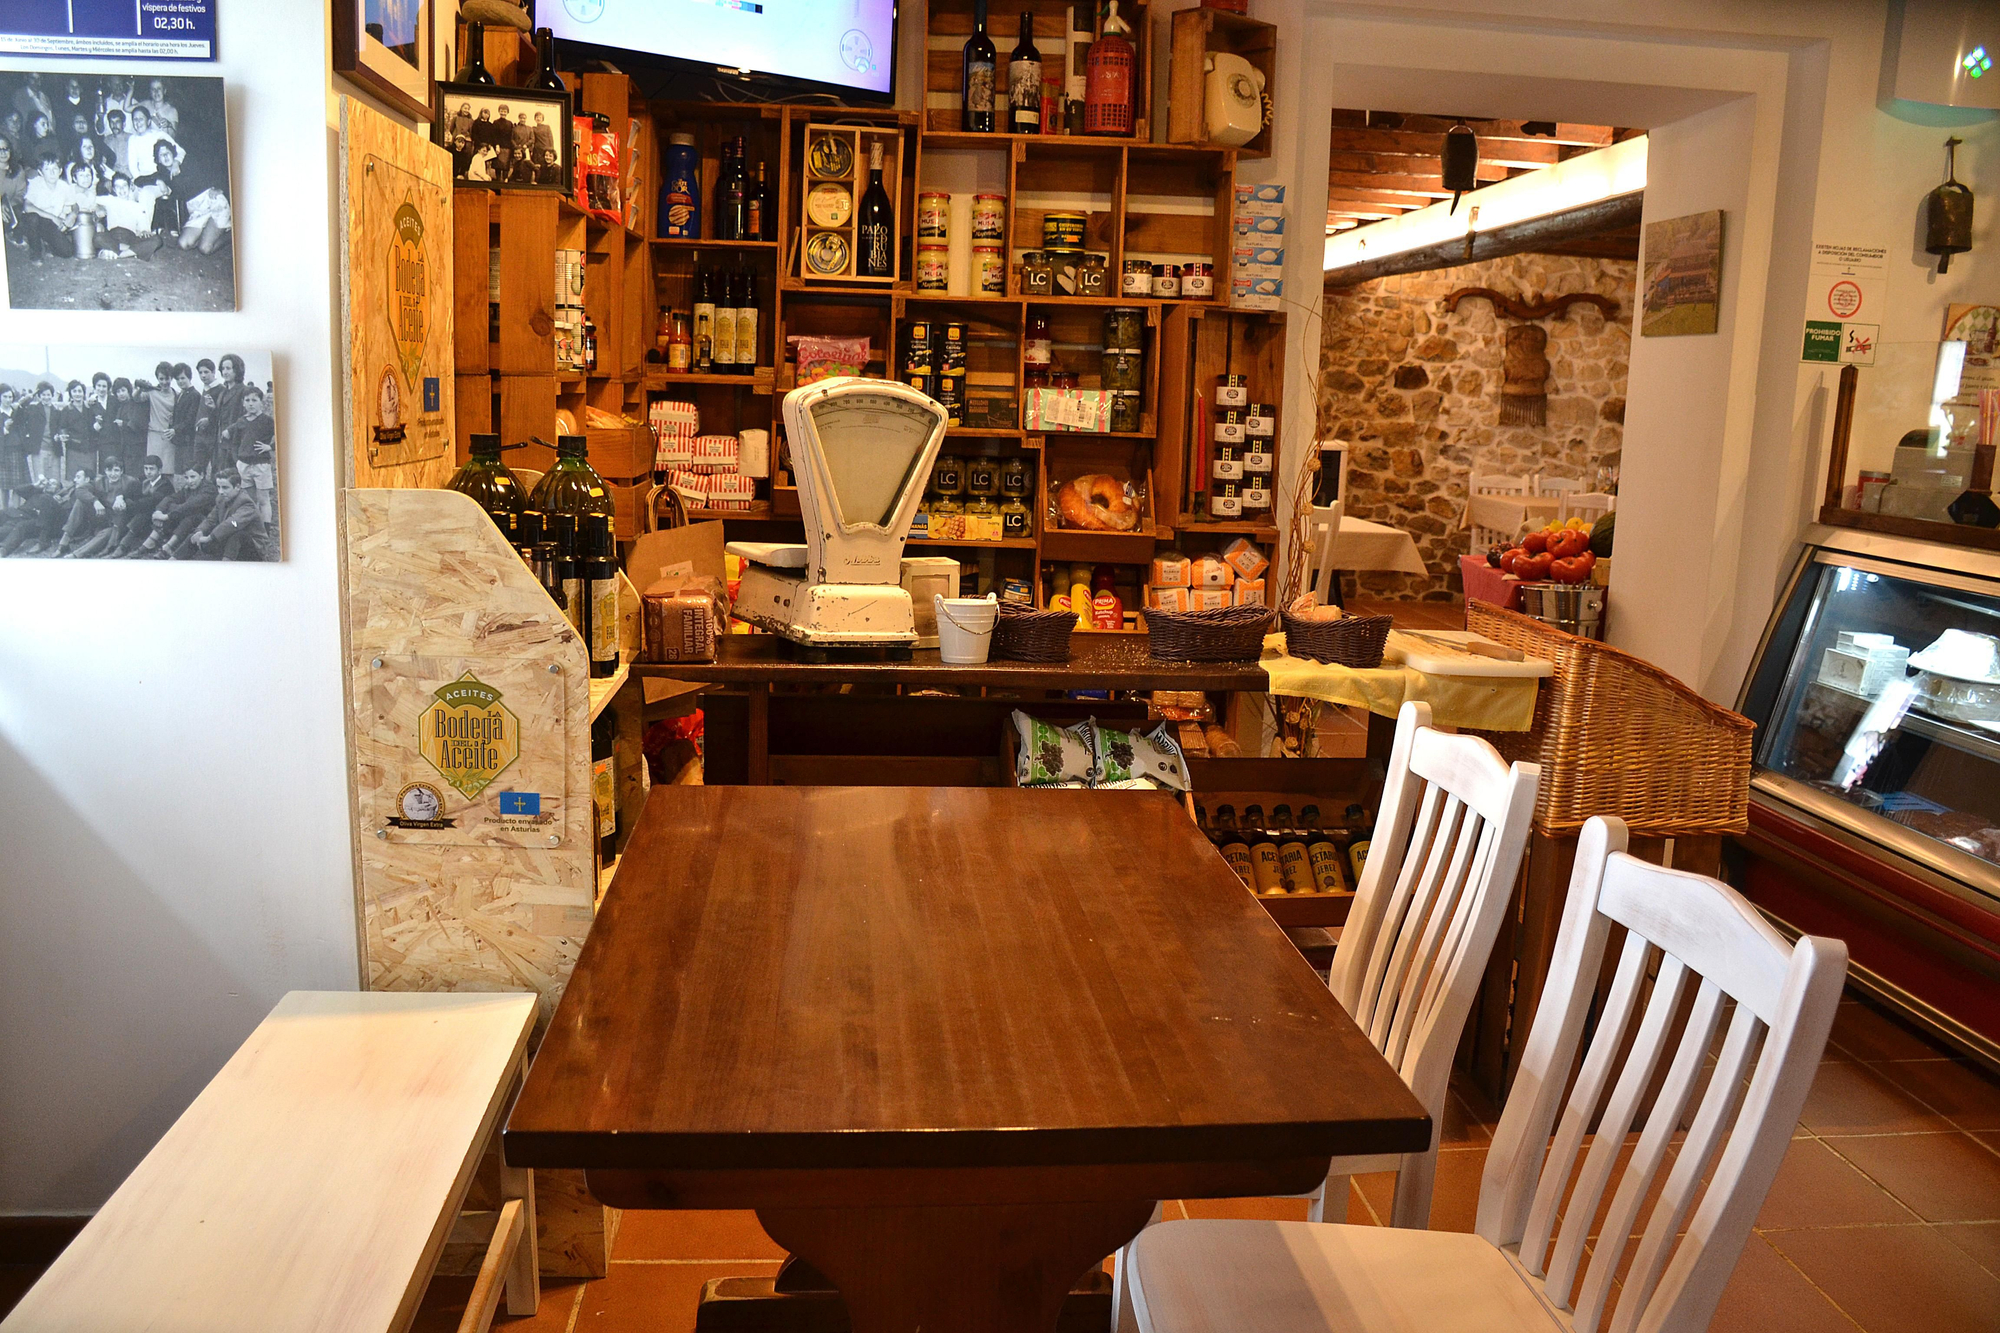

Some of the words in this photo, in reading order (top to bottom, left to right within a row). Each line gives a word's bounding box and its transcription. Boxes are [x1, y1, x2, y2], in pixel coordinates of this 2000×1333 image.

[142, 3, 167, 13] víspera
[168, 4, 177, 12] de
[178, 4, 206, 13] festivos
[154, 17, 184, 30] 02,30
[186, 18, 196, 30] h.
[47, 38, 75, 46] Septiembre,
[399, 216, 421, 236] ACEITES
[395, 245, 426, 305] Bodega
[1030, 273, 1047, 286] LC
[1084, 273, 1101, 286] LC
[398, 296, 424, 343] Aceite
[1805, 328, 1841, 336] PROHIBIDO
[940, 472, 956, 485] LC
[973, 473, 989, 486] LC
[1006, 474, 1022, 486] LC
[1006, 514, 1022, 527] LC
[1094, 597, 1114, 605] PRIMA
[683, 609, 694, 655] FAMILIAR
[694, 607, 705, 654] INTEGRAL
[705, 617, 716, 645] 100%
[446, 689, 494, 701] ACEITES
[434, 709, 503, 745] Bodega
[441, 740, 498, 770] Aceite
[484, 817, 517, 825] Producto
[1317, 864, 1337, 875] JEREZ
